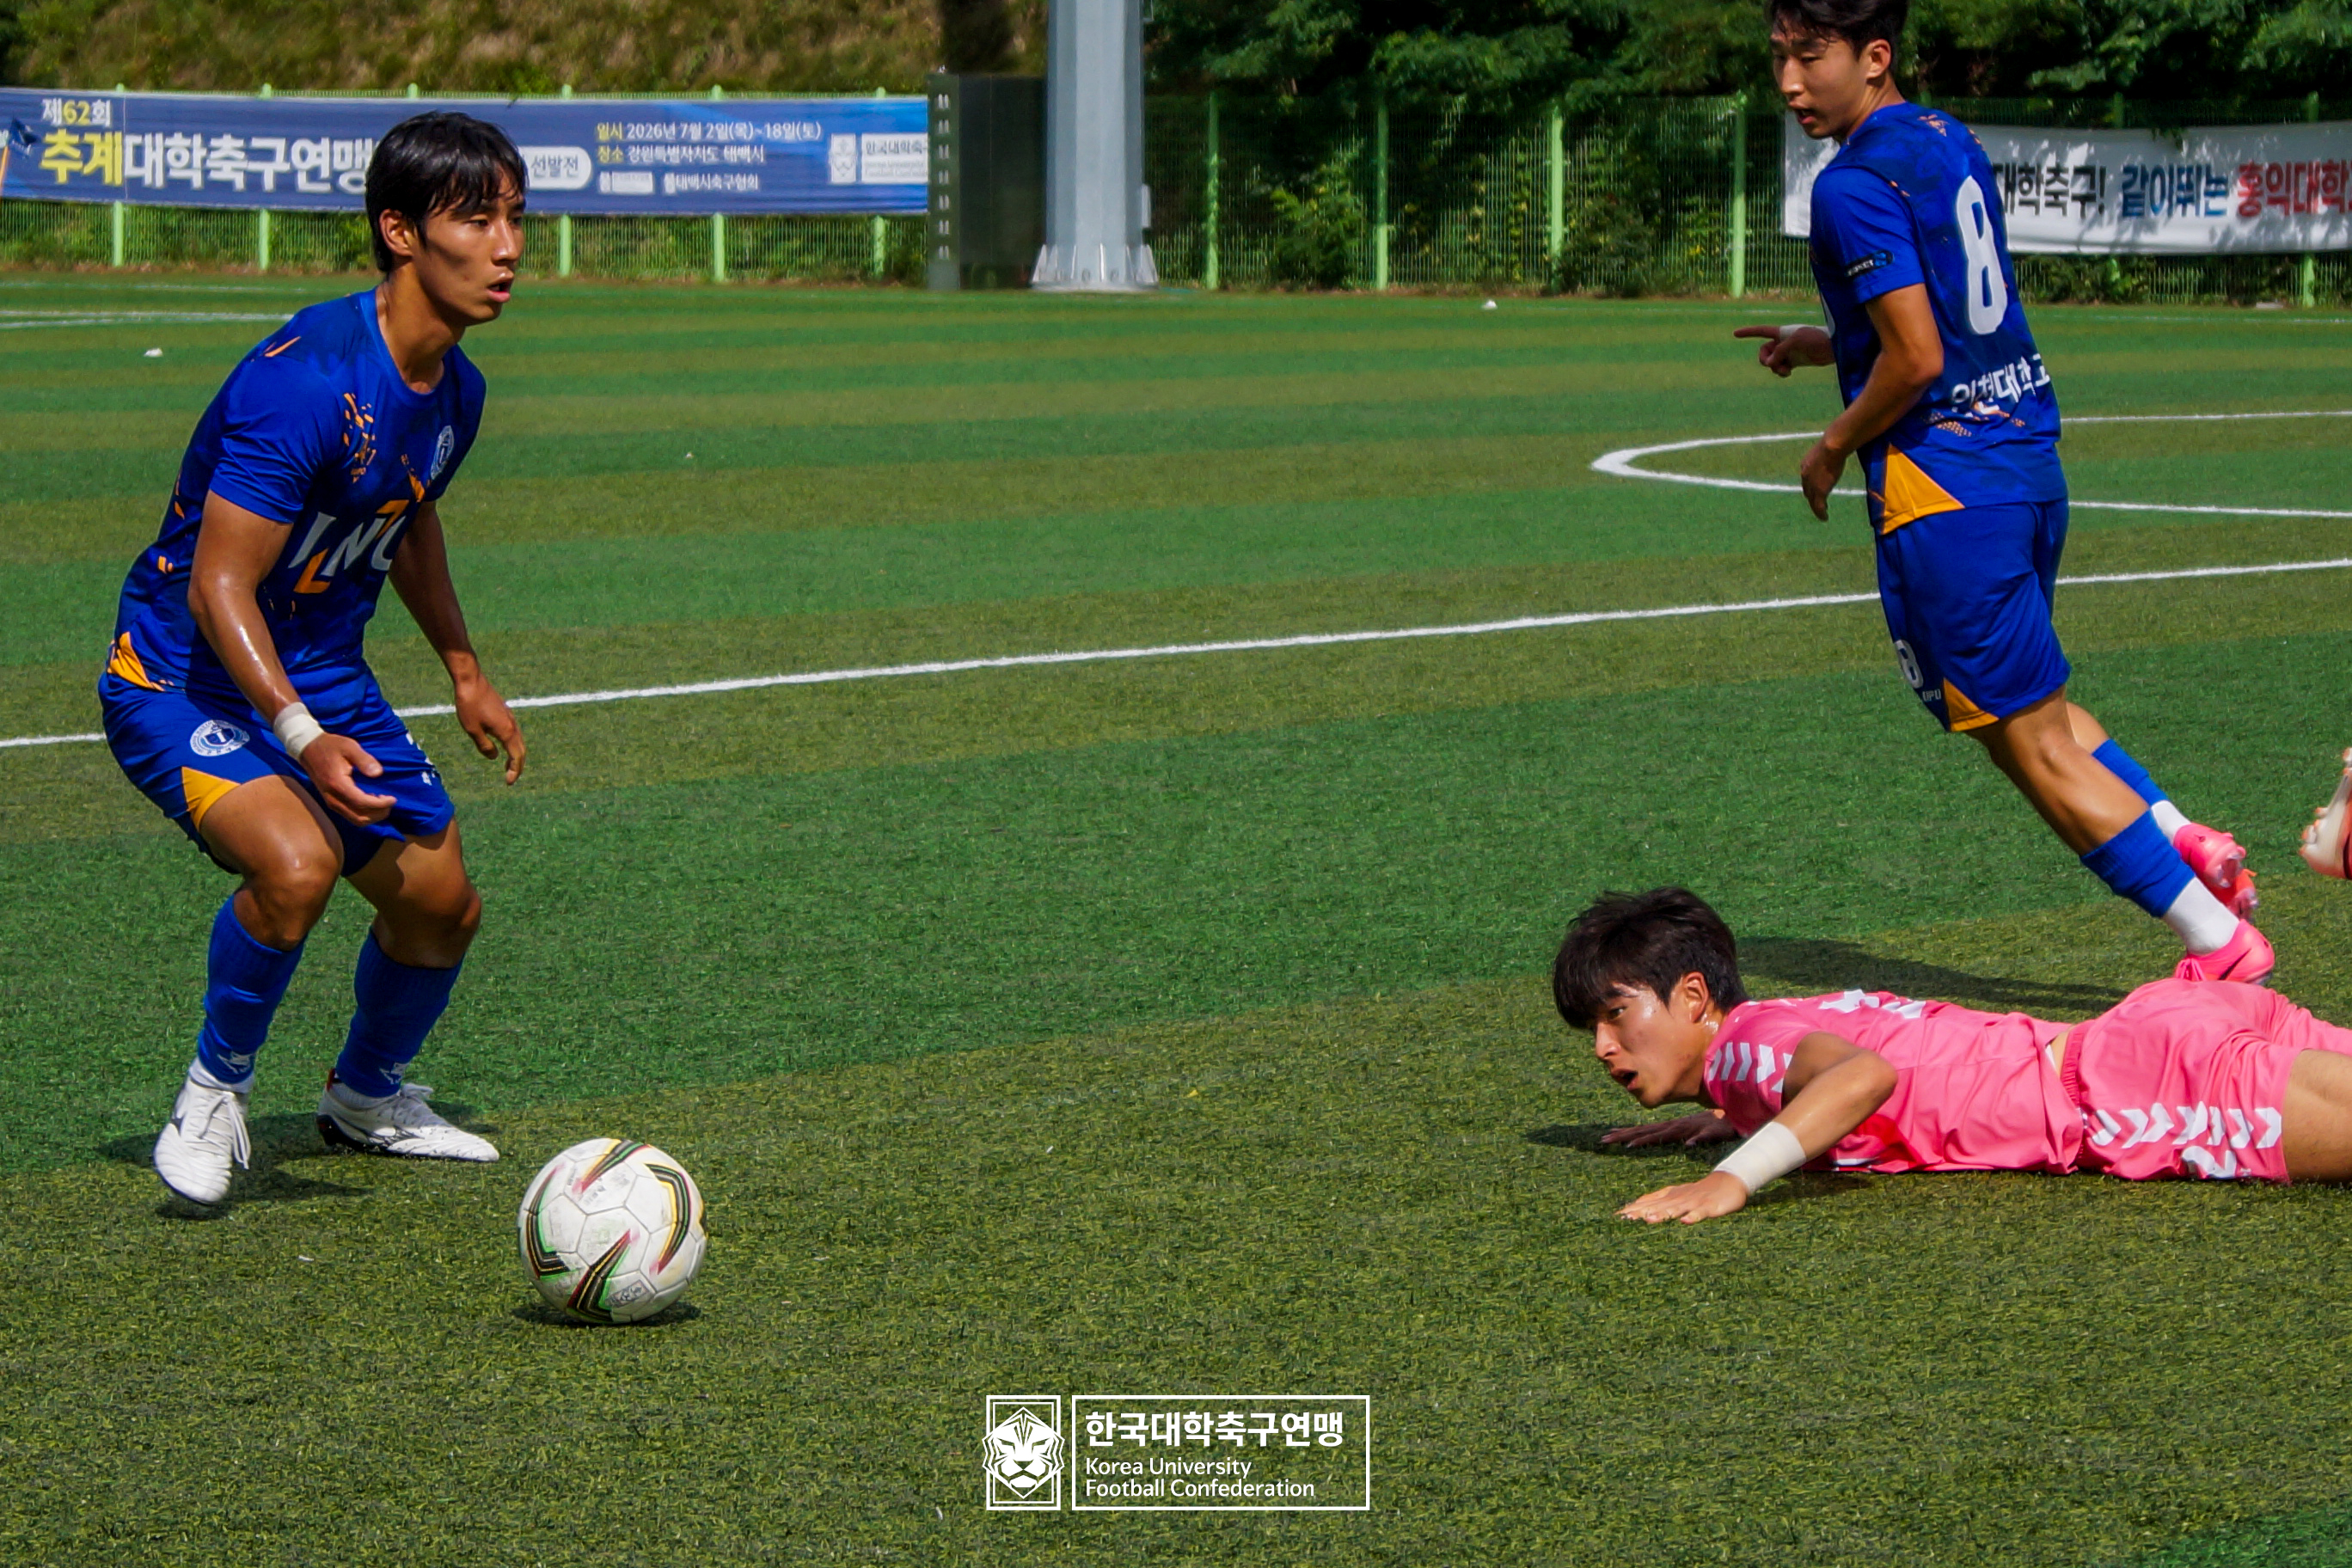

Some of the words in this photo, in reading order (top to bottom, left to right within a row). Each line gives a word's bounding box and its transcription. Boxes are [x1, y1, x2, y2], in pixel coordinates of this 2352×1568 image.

[41, 97, 112, 127] 제62회
[597, 122, 623, 142] 일시
[627, 122, 677, 141] 2026년
[680, 122, 702, 141] 7월
[40, 129, 380, 195] 추계대학축구연맹
[530, 154, 579, 179] 선발전
[597, 144, 624, 164] 장소
[2122, 162, 2229, 218] 같이뛰는
[2237, 159, 2352, 217] 홍익대학
[1957, 175, 2008, 334] 8
[1894, 639, 1924, 688] 8
